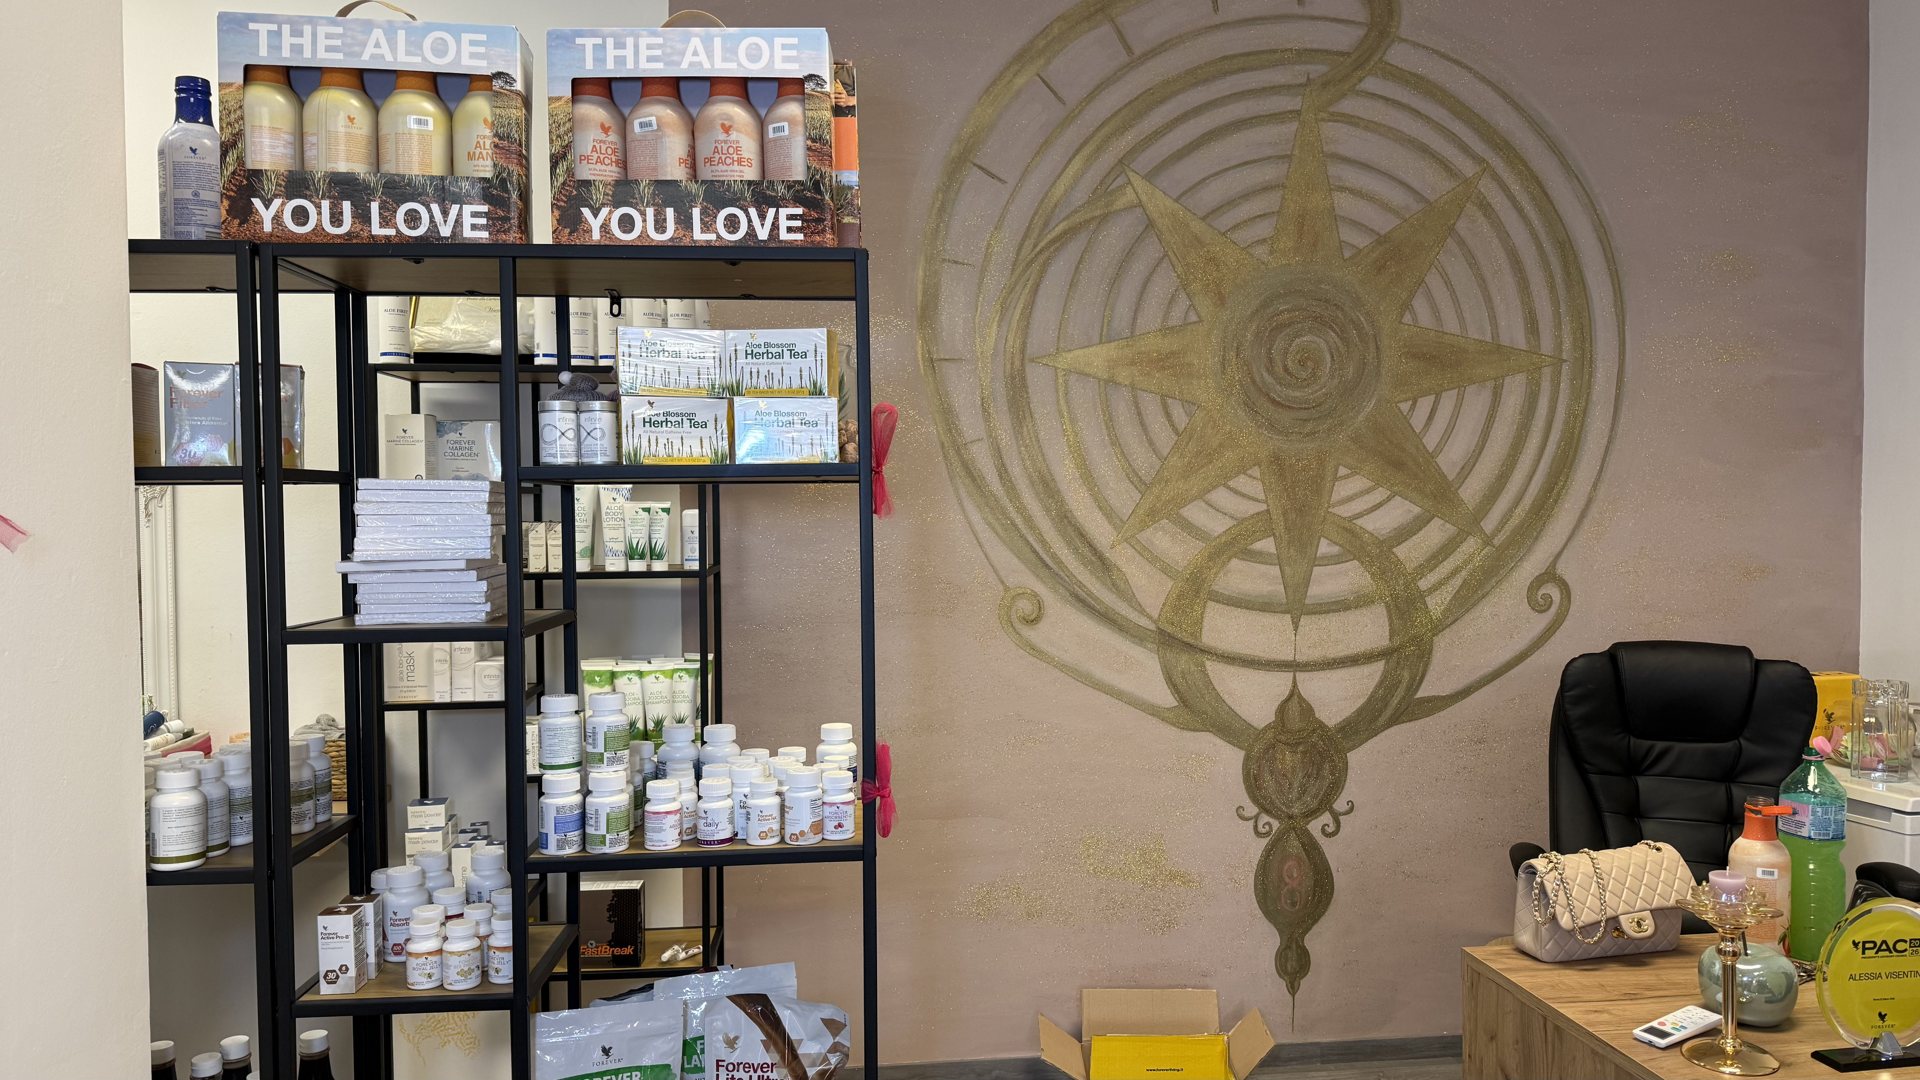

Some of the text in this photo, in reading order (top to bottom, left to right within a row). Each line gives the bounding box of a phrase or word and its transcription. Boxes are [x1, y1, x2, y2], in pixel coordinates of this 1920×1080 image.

[248, 22, 488, 67] THE ALOE
[575, 37, 800, 70] THE ALOE
[474, 141, 494, 150] AL
[712, 146, 742, 156] ALOE
[467, 151, 494, 162] MAN
[590, 145, 620, 158] ALOE
[579, 155, 627, 170] PEACHES
[704, 156, 753, 168] PEACHES
[251, 197, 490, 239] YOU LOVE
[580, 206, 804, 241] YOU LOVE
[640, 339, 658, 347] Aloe
[640, 346, 681, 359] Herbal
[745, 349, 808, 360] Herbal Tea
[643, 417, 708, 428] Herbal Tea
[800, 418, 818, 428] Tea
[404, 651, 416, 682] mask
[703, 818, 719, 829] daily
[581, 946, 634, 955] FastBreak
[1861, 938, 1908, 955] PAC
[1848, 972, 1882, 981] ALESSIA
[592, 1058, 622, 1067] FOREVER
[716, 1060, 776, 1074] Forever
